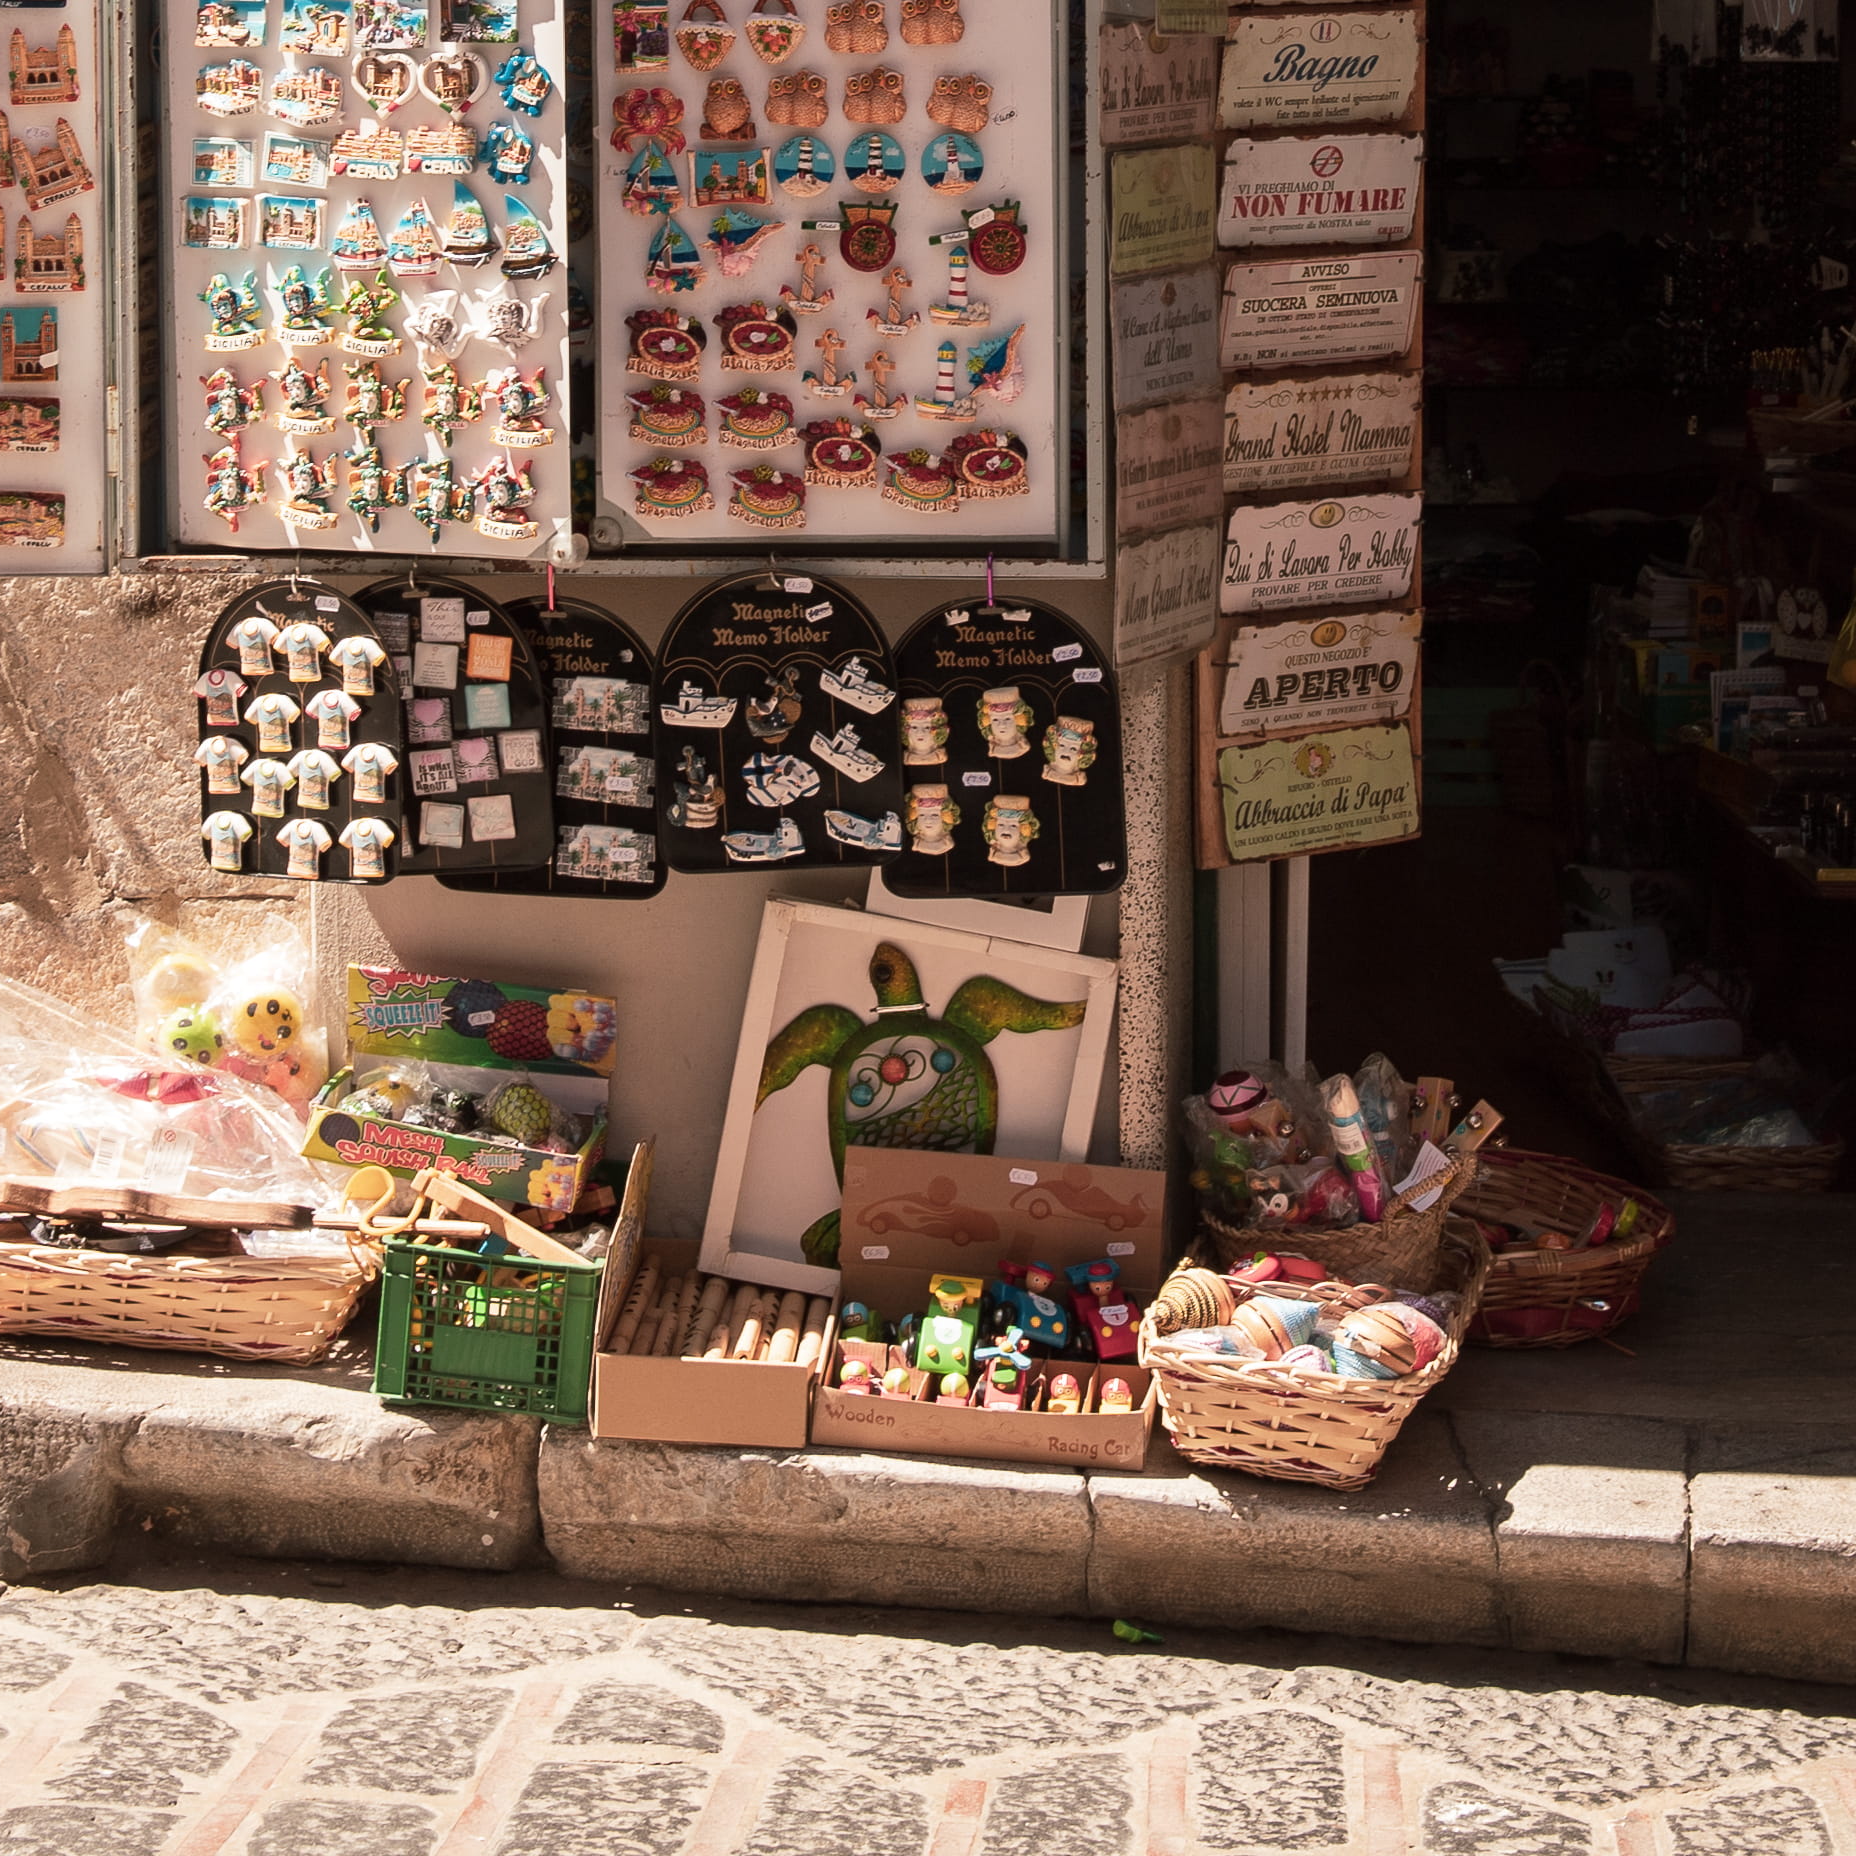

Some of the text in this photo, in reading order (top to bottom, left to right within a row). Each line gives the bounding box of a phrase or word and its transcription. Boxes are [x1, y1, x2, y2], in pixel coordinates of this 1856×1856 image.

[1263, 43, 1380, 93] Bagno
[1265, 97, 1282, 107] WC
[1238, 180, 1334, 194] VI PREGHIAMO DI
[1231, 187, 1407, 219] NON FUMARE
[1318, 219, 1353, 229] NOSTRA
[1302, 263, 1349, 278] AVVISO
[1241, 289, 1399, 314] SUOCERA SEMINUOVA
[1256, 349, 1278, 359] NON
[1225, 408, 1412, 462] Grand Hotel Mamma
[1225, 527, 1412, 584] Qui Si Lavora Per Hobby
[1251, 575, 1383, 598] PROVARE PER CREDERE
[712, 625, 832, 646] Memo Holder
[955, 625, 1036, 645] Magnetic
[553, 654, 610, 674] Holder
[935, 648, 1052, 668] Memo Holder
[1284, 649, 1360, 669] QUESTO NEGOZIO
[1244, 660, 1403, 710] APERTO
[1273, 712, 1303, 724] QUANDO
[1306, 710, 1322, 718] NON
[1234, 794, 1325, 831] Abbraccio
[1331, 786, 1349, 815] di
[364, 1004, 442, 1025] SQUEEZE IT!
[363, 1121, 444, 1154] MESH
[336, 1140, 432, 1170] SQUISH
[434, 1157, 492, 1186] BALL
[824, 1402, 895, 1427] Wooden
[1047, 1436, 1132, 1459] Racing Car
